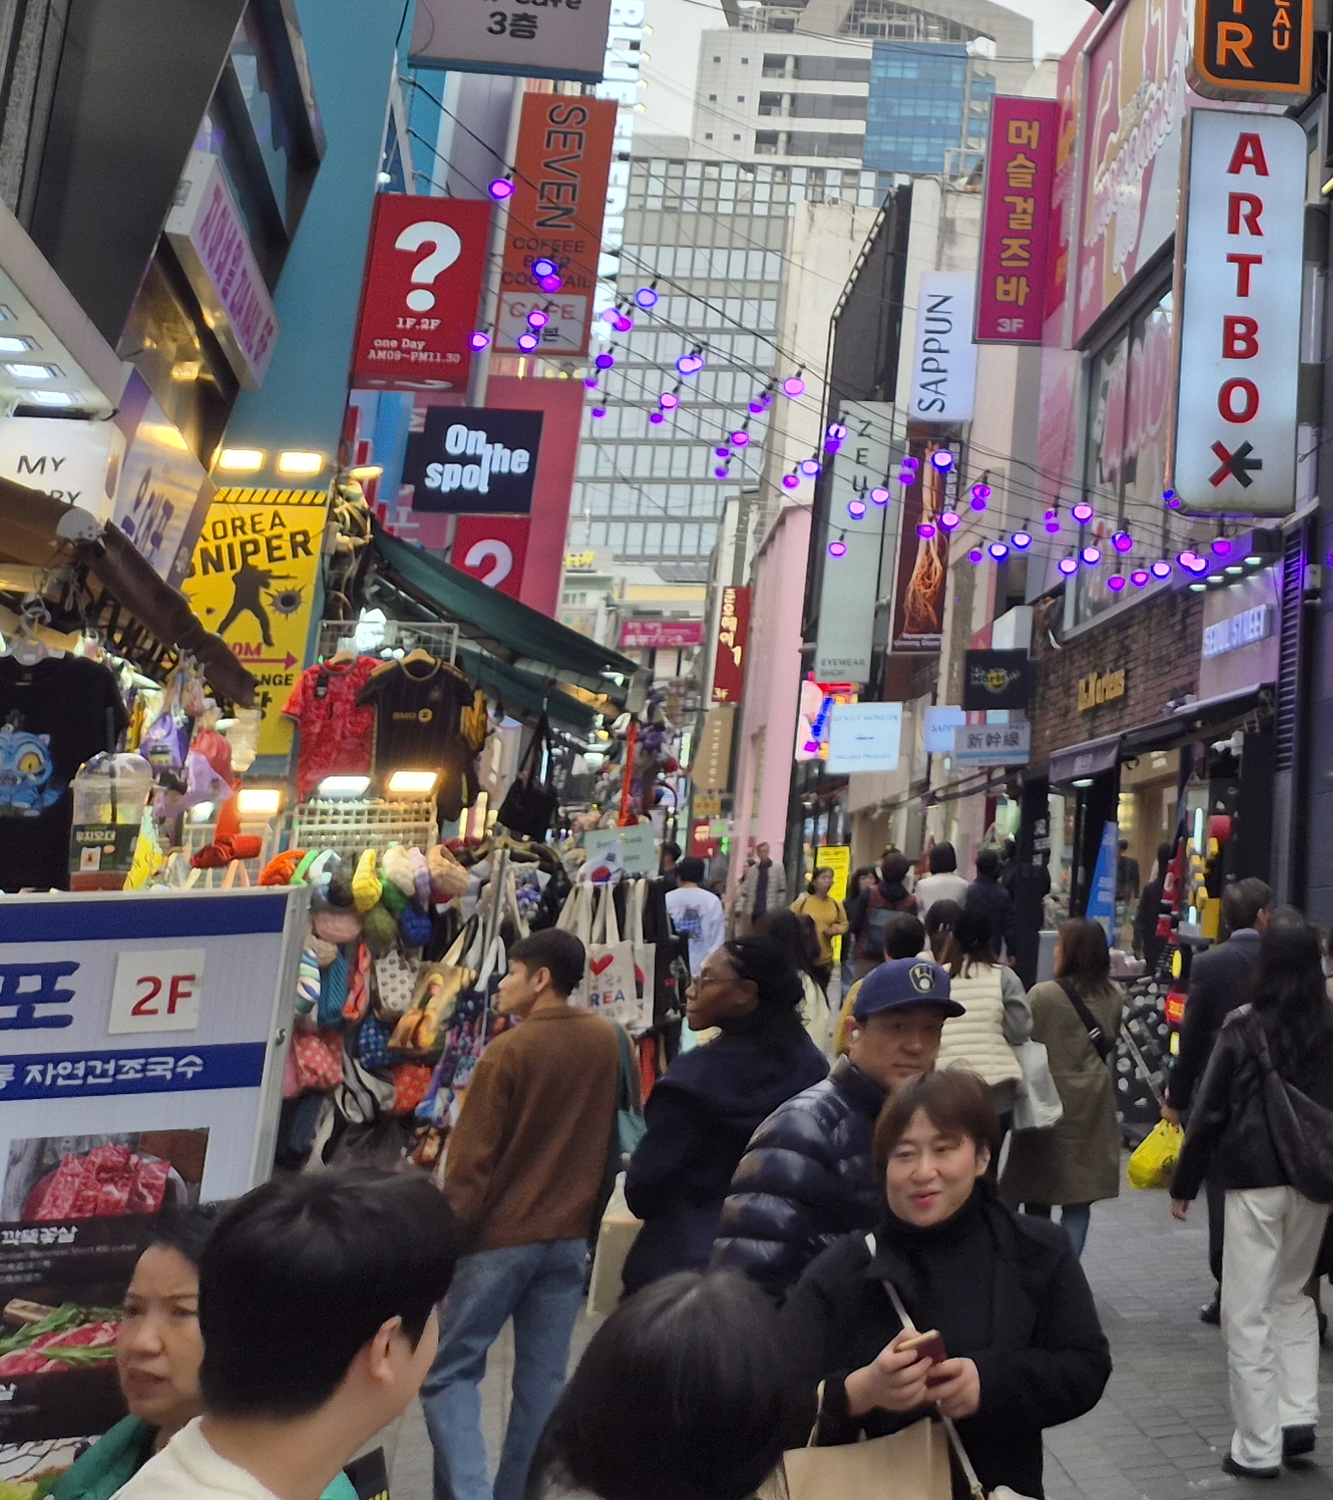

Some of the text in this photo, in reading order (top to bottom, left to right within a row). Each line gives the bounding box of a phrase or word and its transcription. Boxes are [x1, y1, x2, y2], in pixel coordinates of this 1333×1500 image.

[486, 10, 539, 40] 3층
[535, 103, 588, 230] SEVEN
[995, 120, 1040, 307] 머슬걸즈바
[512, 237, 585, 253] COFFEE
[524, 255, 570, 268] BR
[501, 271, 591, 288] COCAIL
[1208, 132, 1269, 489] ARTBOX
[396, 317, 441, 330] 1F.2F
[996, 318, 1024, 333] 3F
[373, 339, 427, 351] one Day
[917, 293, 954, 413] SAPPUN
[445, 424, 487, 456] On
[16, 455, 66, 476] MY
[188, 528, 314, 579] NIPER
[820, 658, 865, 668] EYEWEAR
[820, 669, 845, 677] SHOP
[131, 974, 196, 1016] 2F
[23, 1055, 204, 1086] 자연건조국수
